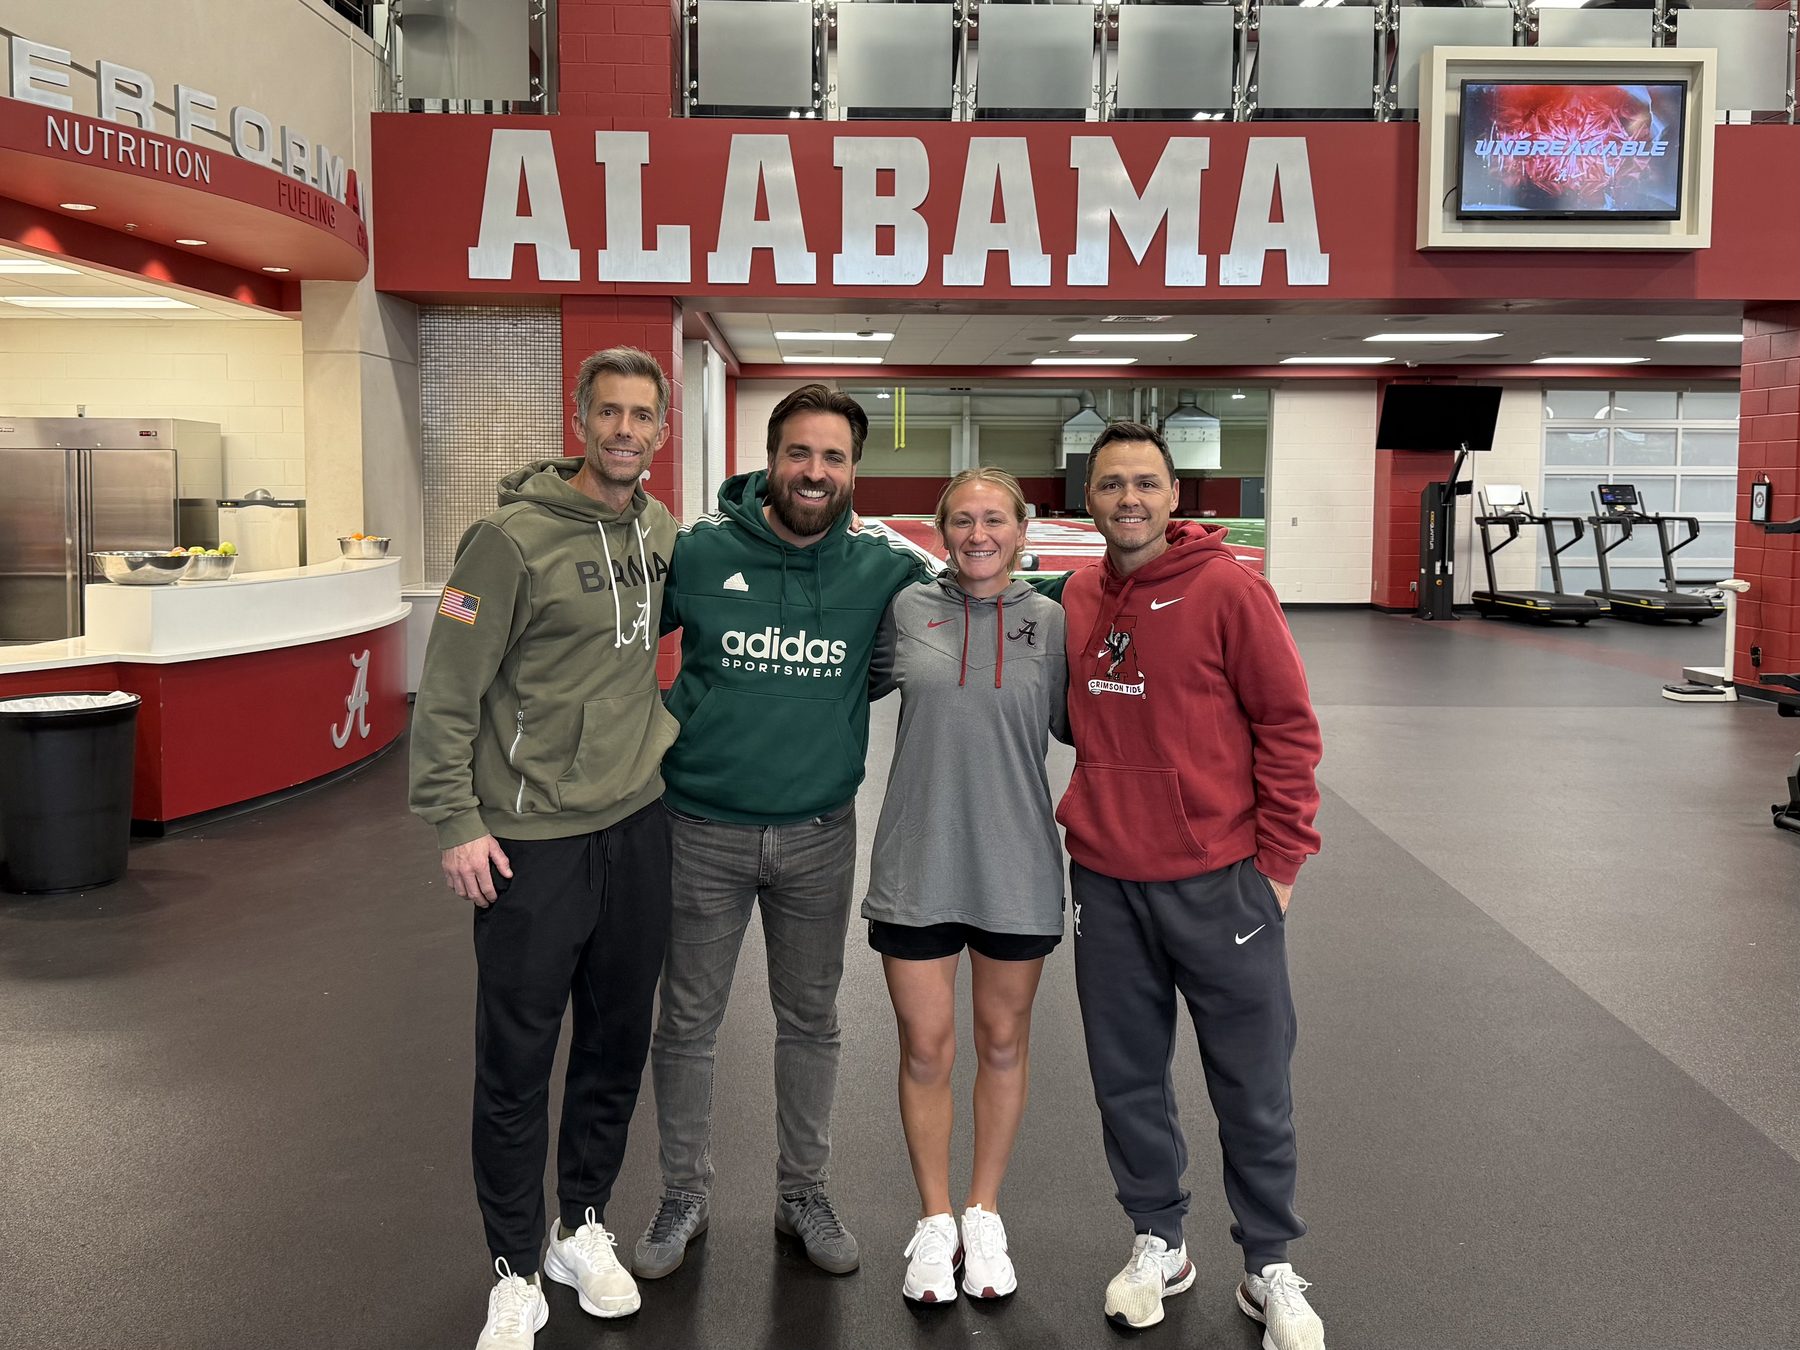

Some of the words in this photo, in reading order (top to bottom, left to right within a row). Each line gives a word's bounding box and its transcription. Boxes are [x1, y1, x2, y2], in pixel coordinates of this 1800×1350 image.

[47, 115, 210, 184] NUTRITION
[1474, 140, 1669, 157] UNBREAKABLE
[277, 179, 336, 229] FUELING
[467, 128, 1331, 287] ALABAMA
[575, 551, 669, 593] BAMA
[721, 626, 847, 664] adidas
[1006, 617, 1038, 649] A
[721, 657, 842, 678] SPORTSWEAR
[1089, 681, 1124, 692] CRIMSON
[1125, 685, 1142, 694] TIDE
[329, 649, 371, 749] A
